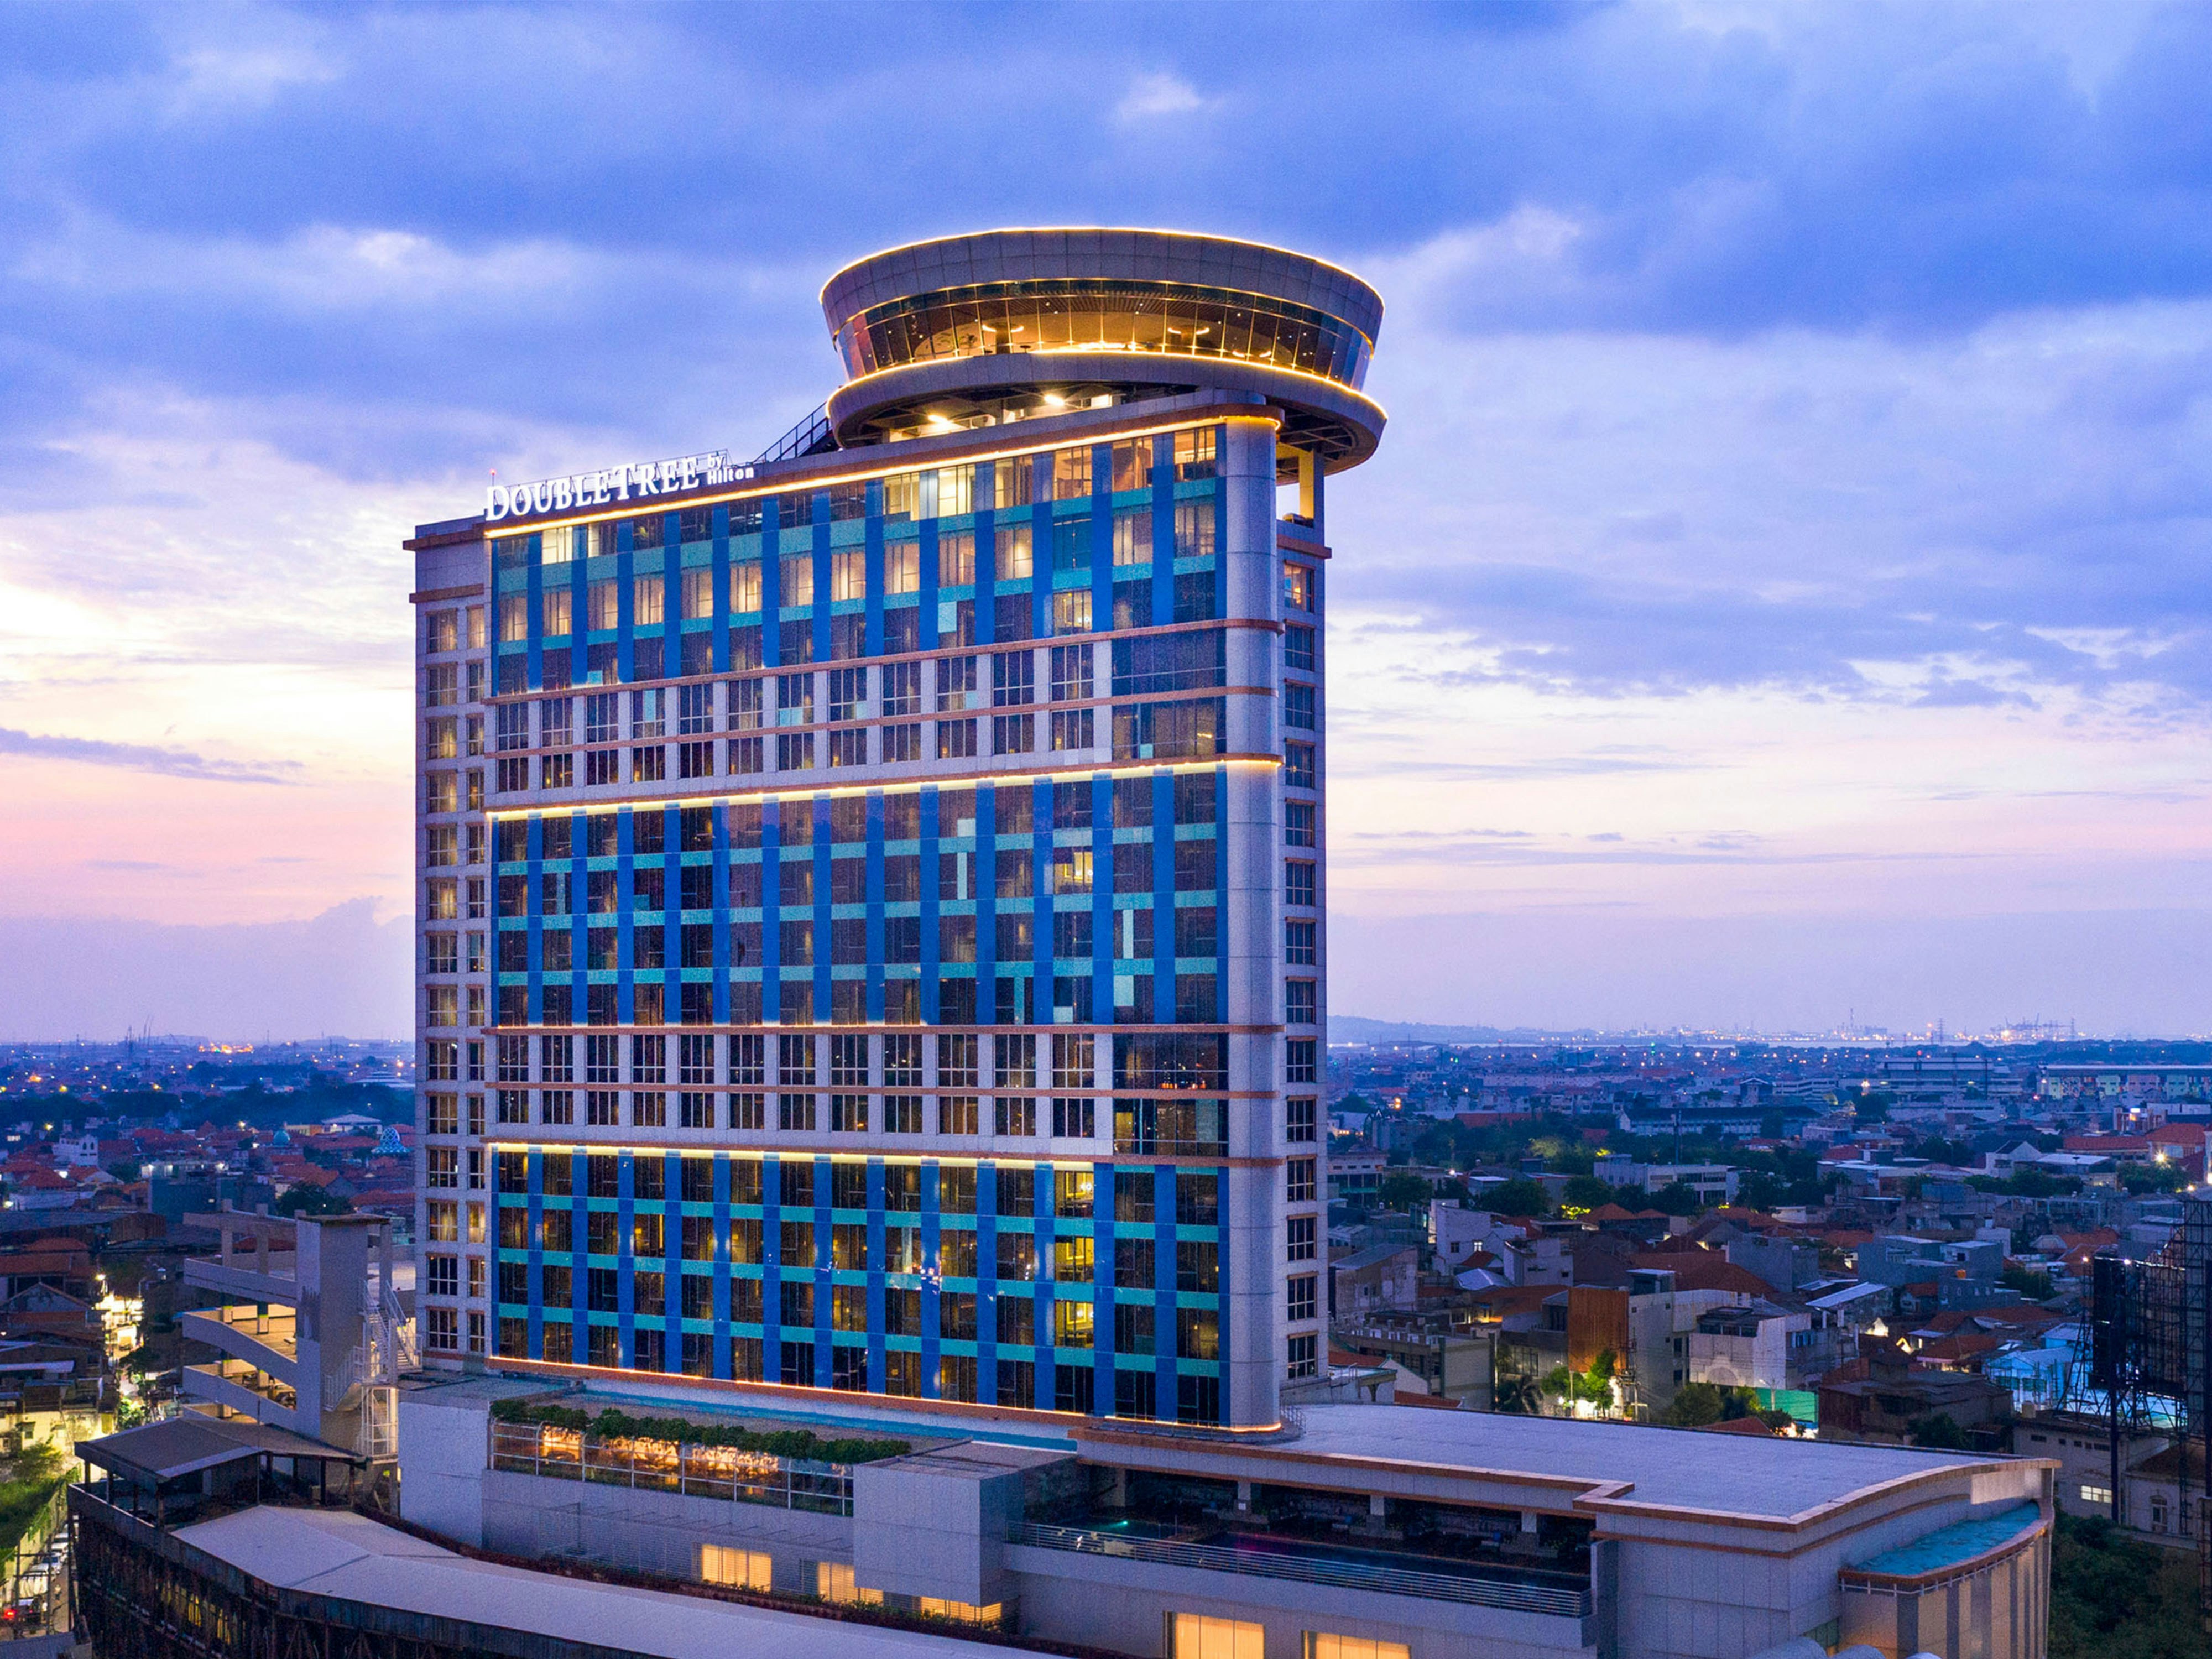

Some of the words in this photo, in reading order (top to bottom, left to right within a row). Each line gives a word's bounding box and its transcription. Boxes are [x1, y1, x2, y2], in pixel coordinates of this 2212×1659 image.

[707, 454, 725, 471] by
[707, 467, 754, 485] Hilton
[486, 457, 700, 521] DOUBLETREE
